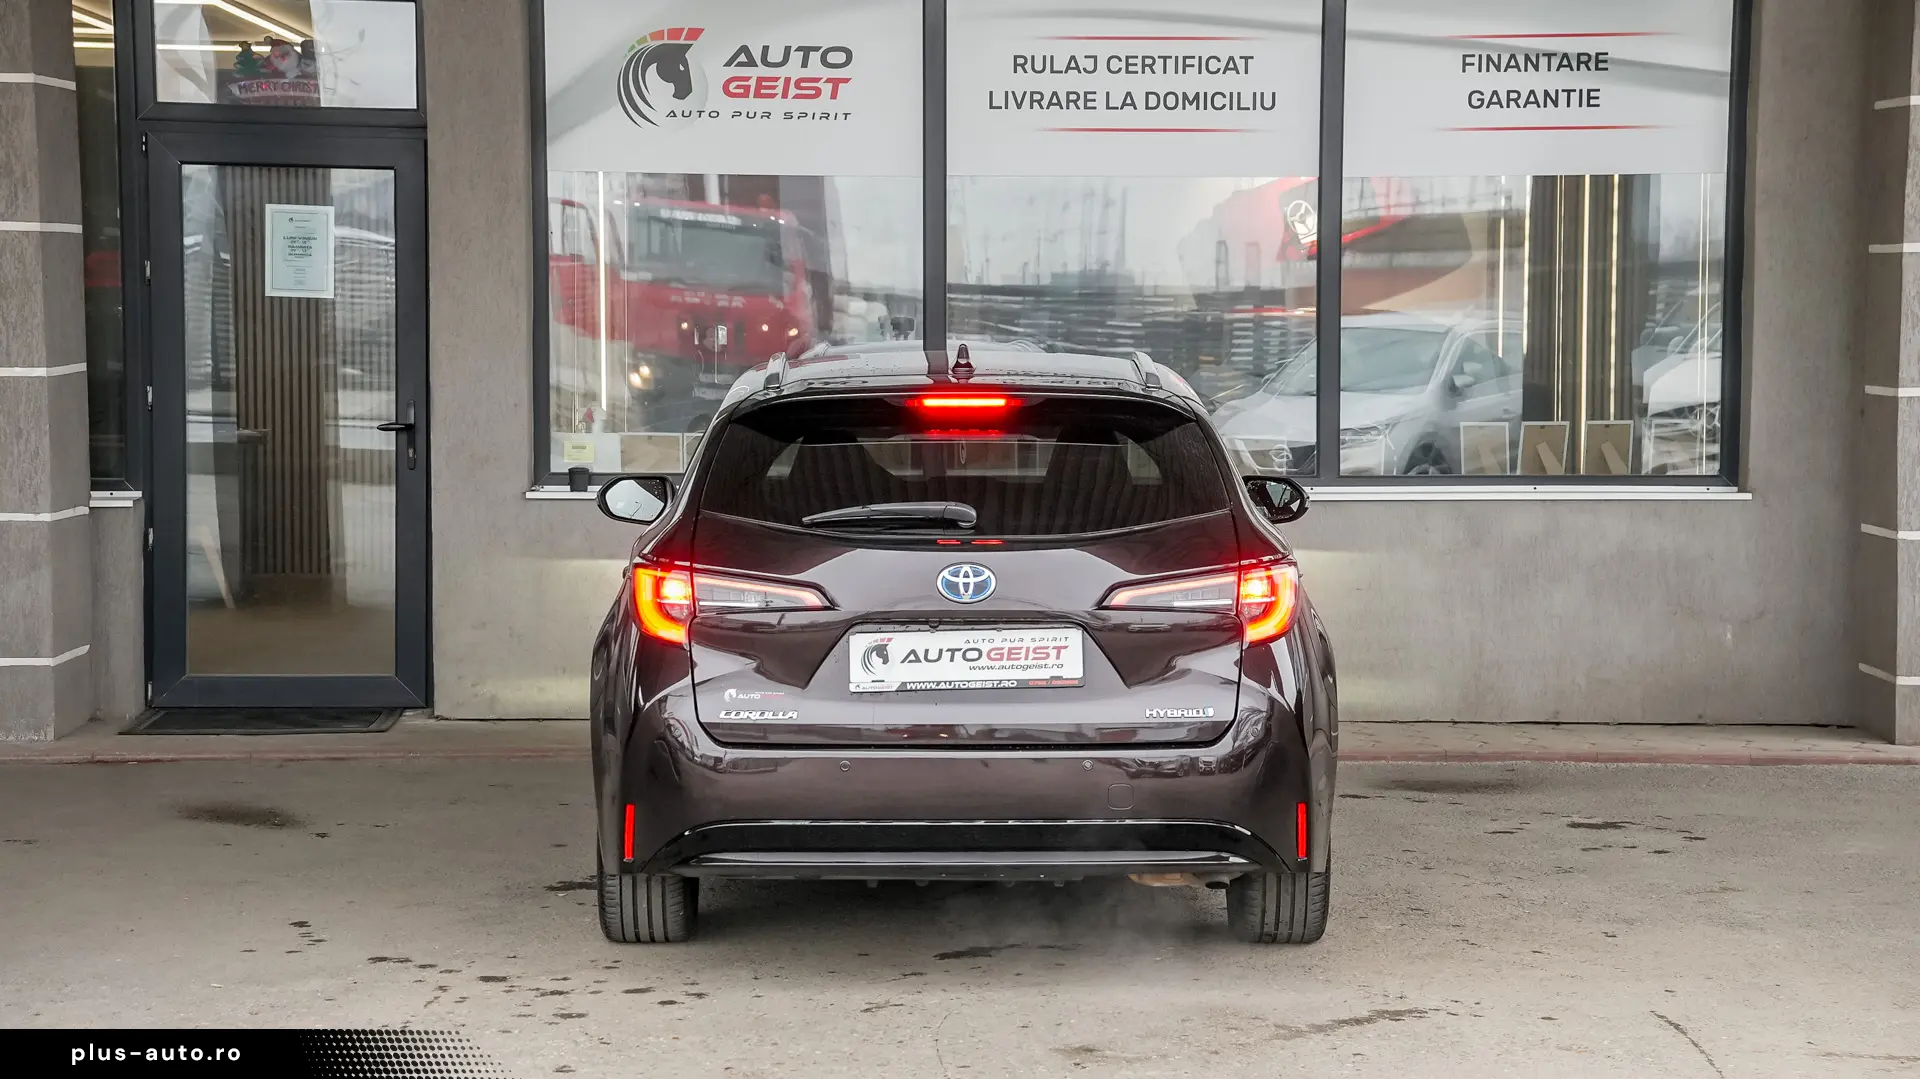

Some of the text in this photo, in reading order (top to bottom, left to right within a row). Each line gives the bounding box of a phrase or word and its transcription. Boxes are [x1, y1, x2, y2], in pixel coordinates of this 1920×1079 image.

[722, 44, 854, 69] AUTO
[1012, 54, 1255, 75] RULAJ CERTIFICAT
[1461, 51, 1609, 73] FINANTARE
[721, 75, 853, 100] GEIST
[988, 90, 1277, 111] LIVRARE LA DOMICILIU
[1467, 88, 1601, 110] GARANTIE
[665, 109, 852, 121] AUTO PUR SPIRIT
[968, 662, 1064, 672] www.autogeist.ro
[906, 679, 1018, 690] WWW.AUTOGEIST.RO
[719, 709, 798, 720] COROLLA
[1145, 708, 1204, 718] HYBRID
